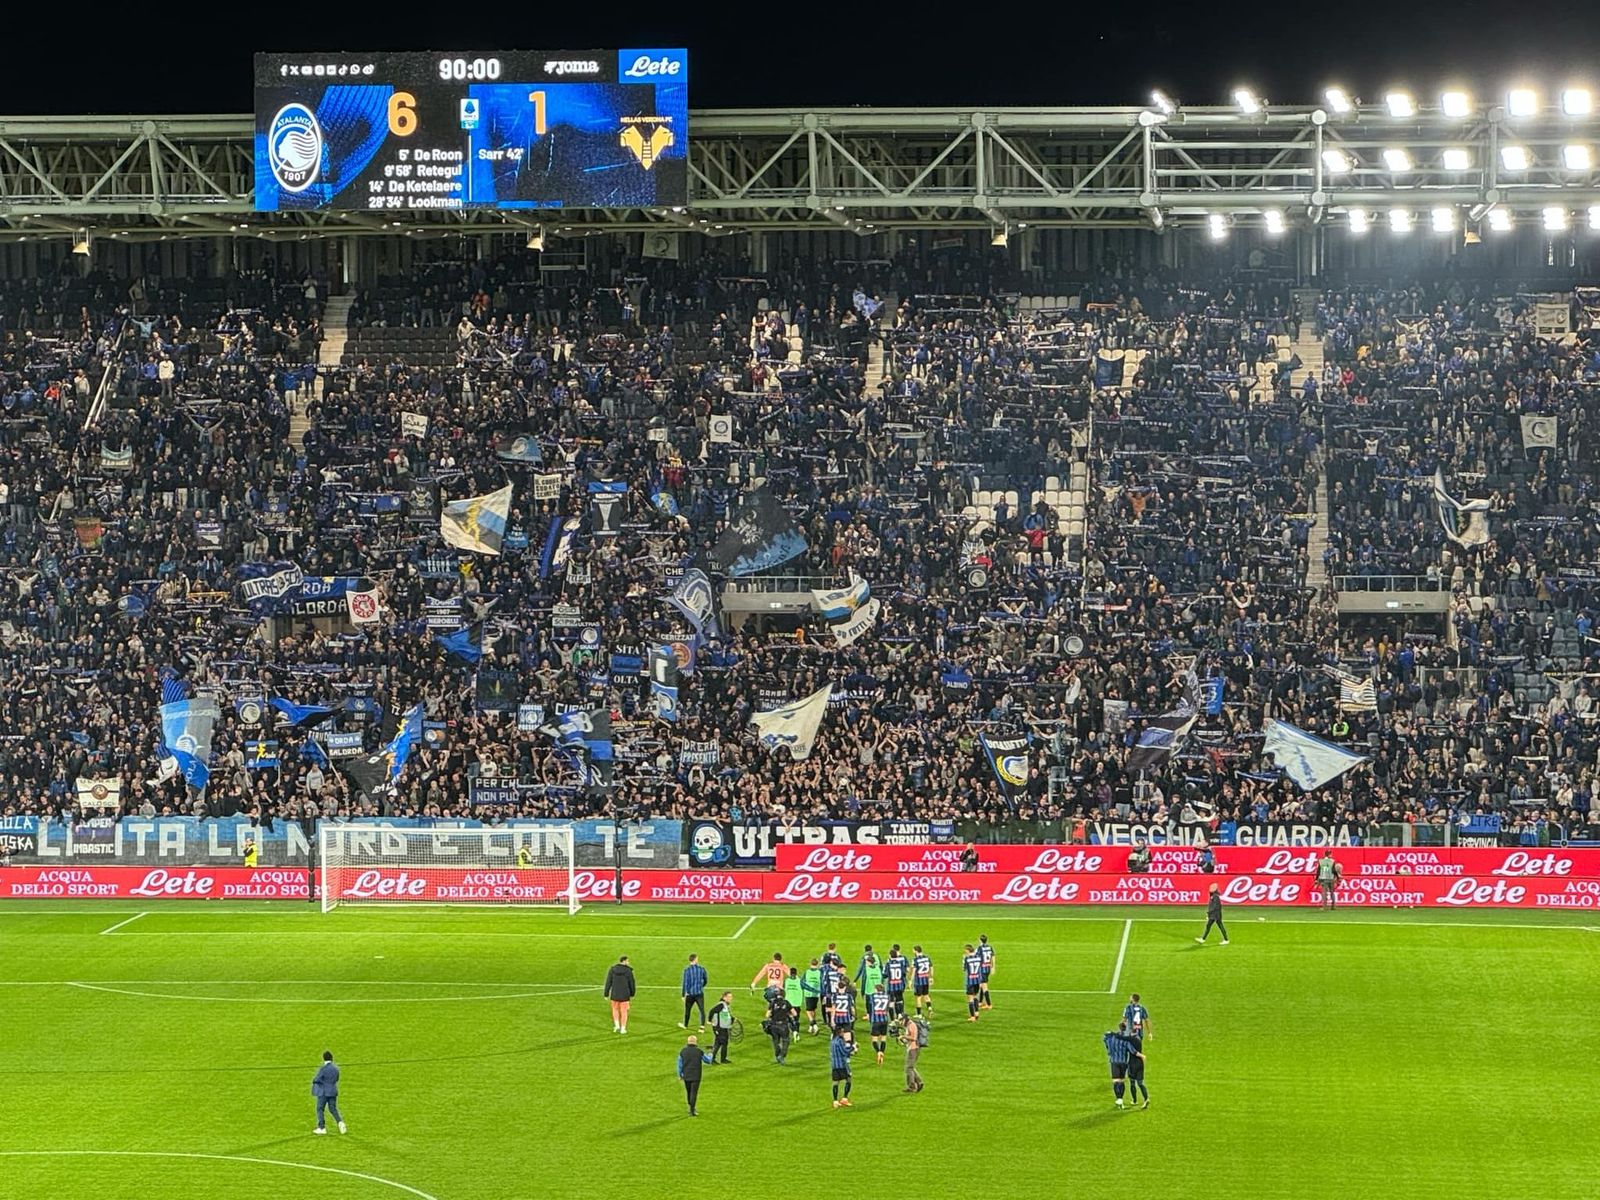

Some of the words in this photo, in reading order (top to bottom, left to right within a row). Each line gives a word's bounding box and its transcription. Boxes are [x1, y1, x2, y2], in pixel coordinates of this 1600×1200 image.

[439, 59, 500, 79] 90:00
[625, 55, 680, 77] Lete
[388, 92, 418, 136] 6
[529, 91, 546, 135] 1
[277, 116, 312, 128] ATALANTA
[414, 149, 431, 161] De
[432, 149, 463, 161] Roon
[478, 148, 504, 160] Sarr
[284, 171, 306, 182] 1907
[388, 180, 405, 193] De
[406, 180, 463, 193] Ketelaere
[408, 196, 463, 209] Lookman
[665, 568, 684, 576] CHE
[243, 577, 278, 598] ULTRAS
[613, 675, 639, 684] OLTA
[475, 778, 497, 788] PER
[476, 791, 497, 801] NON
[890, 823, 930, 834] TANTO
[208, 823, 263, 856] LA
[596, 825, 655, 858] TE
[1094, 823, 1206, 847] VECCHIA
[1236, 824, 1351, 847] GUARDIA
[733, 825, 881, 858] ULTRAS
[795, 847, 872, 871] Lete
[922, 850, 961, 861] ACQU
[1024, 849, 1102, 873] Lete
[1385, 852, 1439, 864] ACQUA
[898, 861, 949, 872] DELLO
[1256, 850, 1320, 874] Let
[1492, 851, 1573, 876] Lete
[1415, 864, 1464, 875] SPORT
[37, 871, 93, 882] ACQUA
[130, 869, 214, 895] Lete
[250, 871, 305, 883] ACQUA
[463, 873, 519, 885] ACQUA
[677, 874, 736, 887] ACQUA
[897, 876, 954, 888] ACQUA
[343, 870, 427, 897] Lete
[557, 872, 641, 898] Lete
[774, 873, 860, 901] Lete
[993, 875, 1079, 902] Lete
[1116, 877, 1174, 889] ACQUA
[1337, 879, 1397, 891] ACQUA
[12, 884, 64, 896] DELLO
[67, 884, 119, 896] SPORT
[224, 884, 275, 896] DELLO
[436, 886, 489, 898] DELLO
[494, 886, 545, 898] SPORT
[651, 888, 705, 900] DELLO
[709, 888, 762, 900] SPORT
[870, 889, 923, 901] DELLO
[927, 889, 981, 901] SPORT
[1218, 876, 1300, 903] Lete
[1435, 877, 1527, 904] Lete
[1089, 890, 1144, 902] DELLO
[1147, 890, 1201, 902] SPORT
[1369, 892, 1424, 904] SPORT
[1536, 893, 1594, 906] DELLO
[768, 968, 781, 980] 29
[890, 968, 901, 979] 10
[836, 999, 849, 1012] 22
[874, 999, 888, 1011] 27
